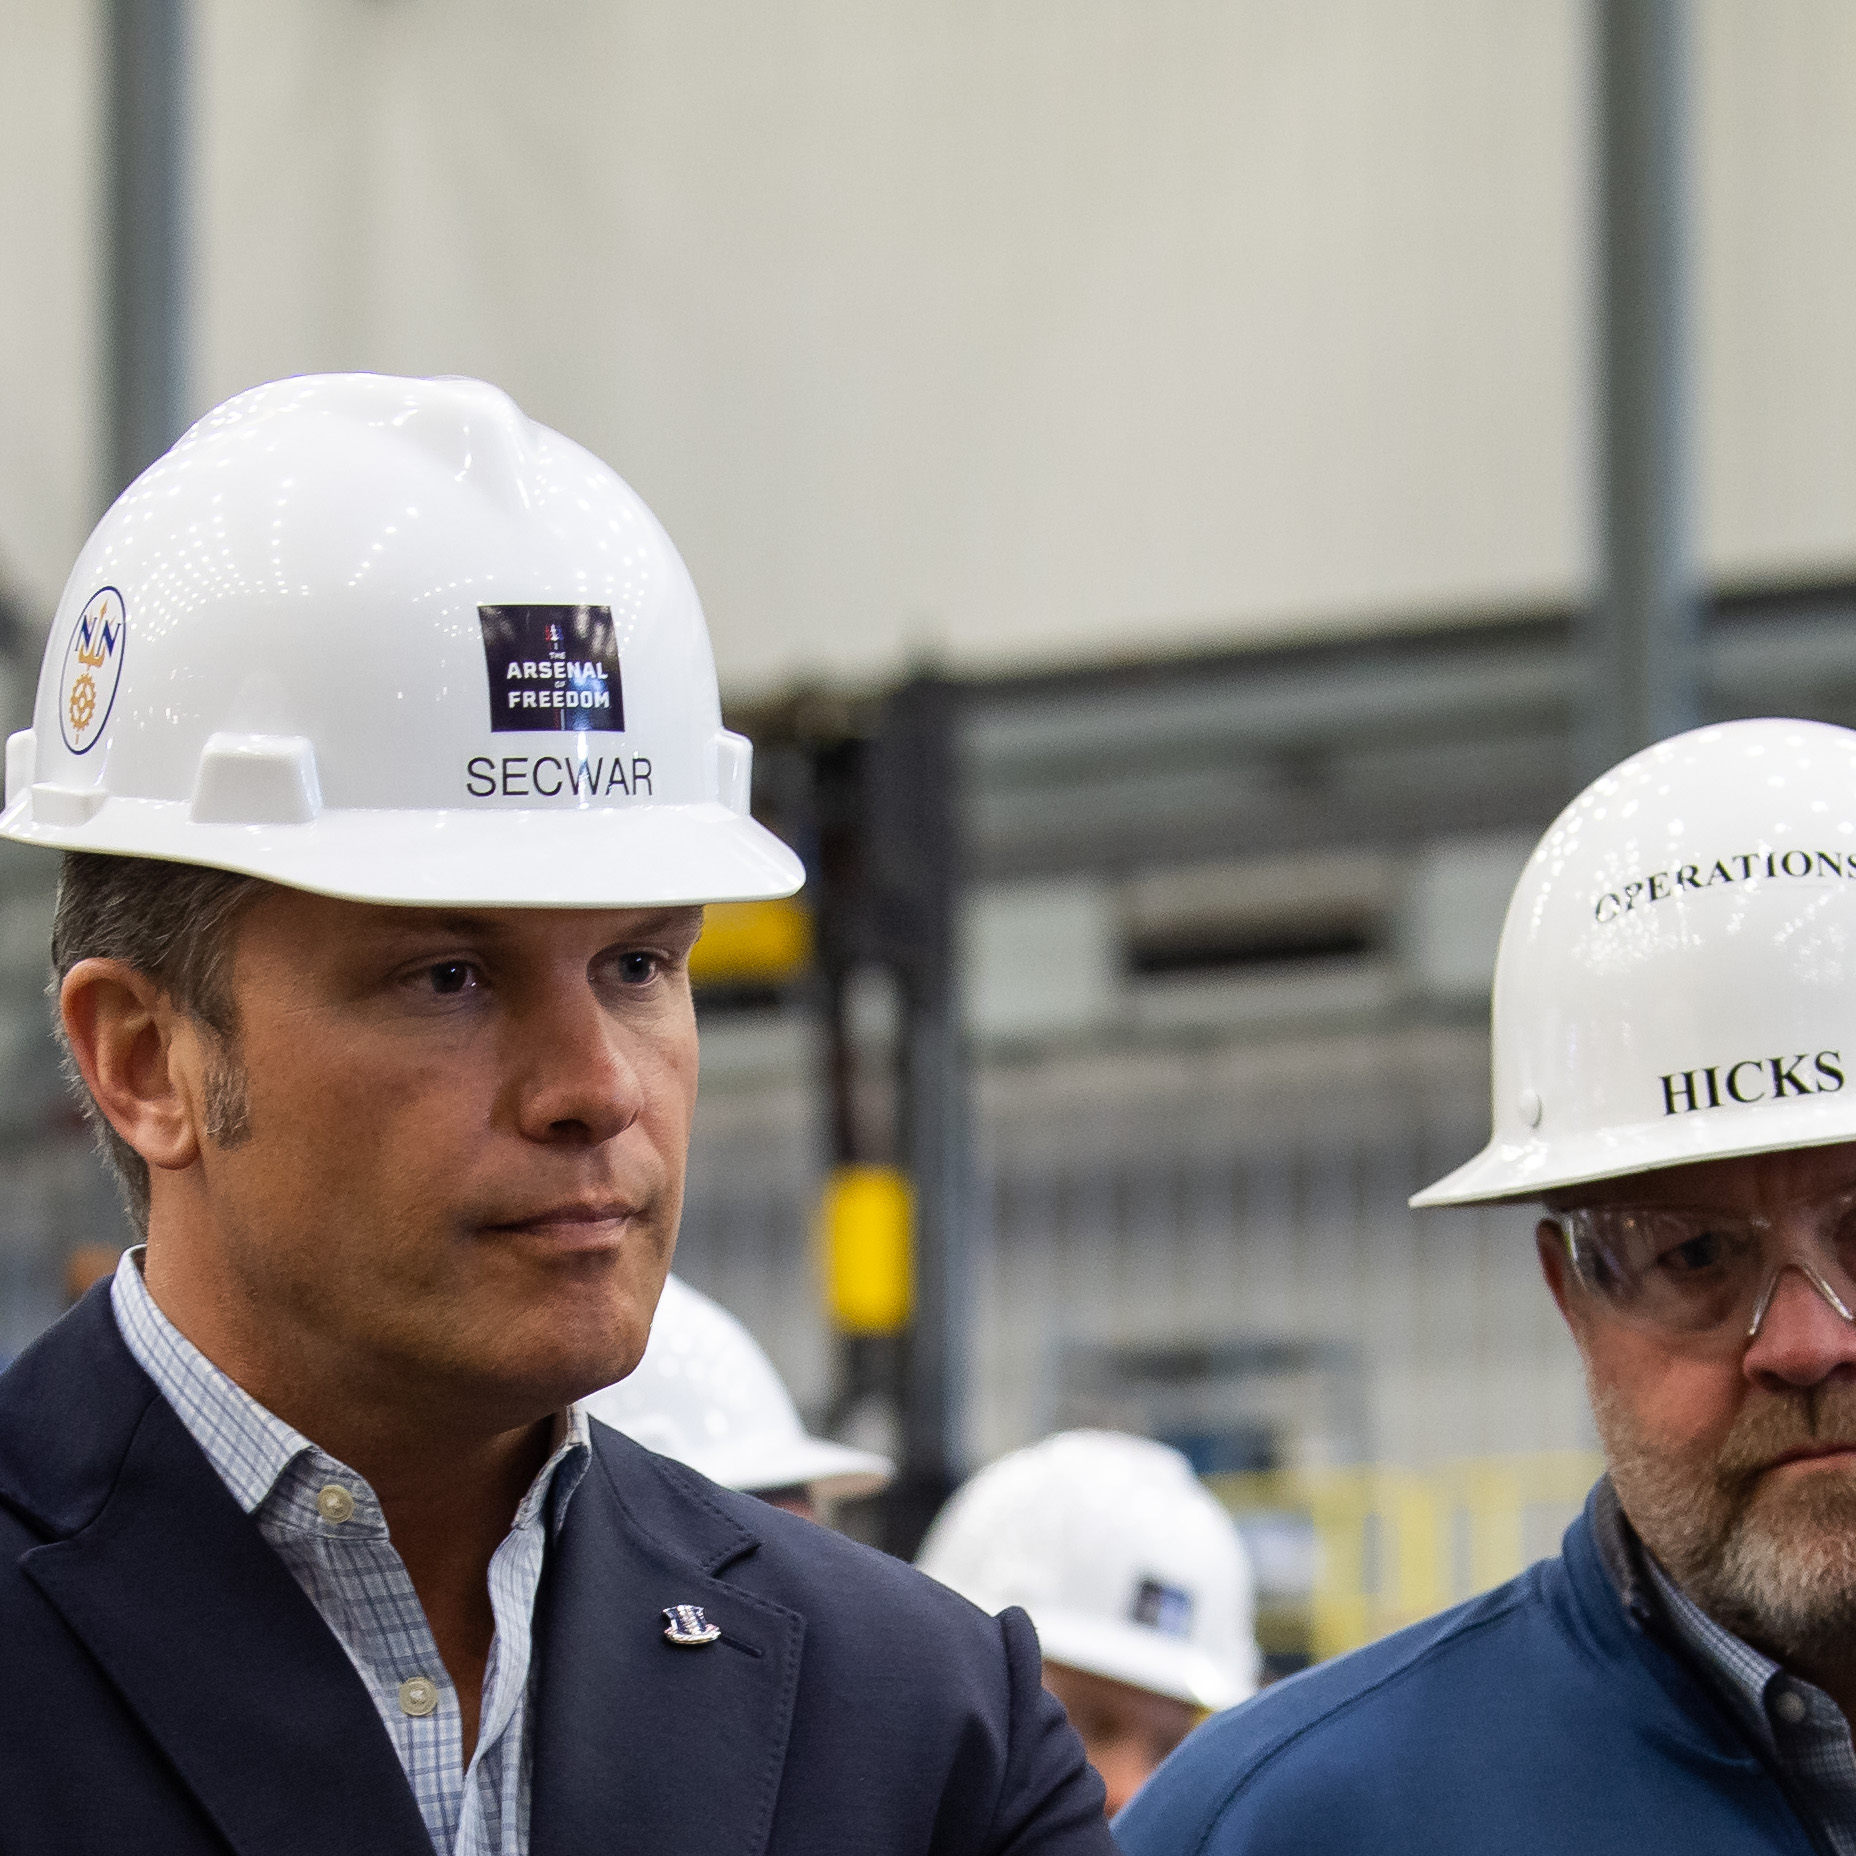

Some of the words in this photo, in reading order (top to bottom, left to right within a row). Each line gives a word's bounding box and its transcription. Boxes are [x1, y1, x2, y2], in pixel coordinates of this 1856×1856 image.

[548, 651, 566, 660] THE
[506, 661, 608, 680] ARSENAL
[508, 691, 610, 709] FREEDOM
[466, 756, 653, 797] SECWAR
[1658, 1050, 1846, 1116] HICKS
